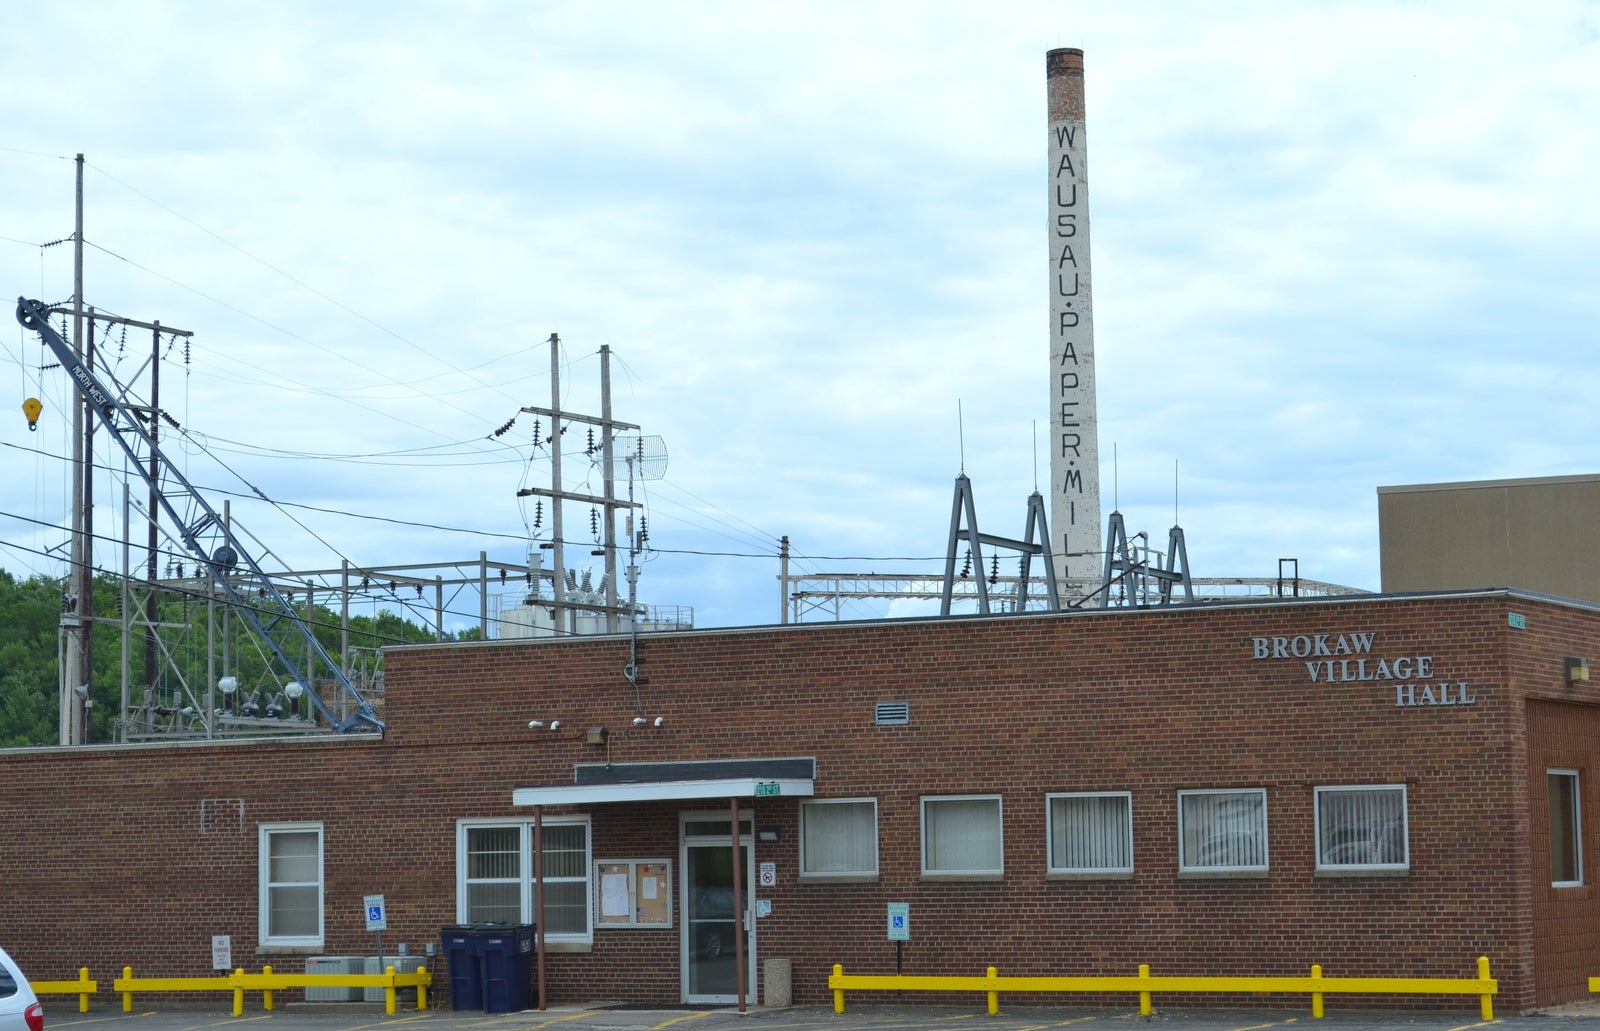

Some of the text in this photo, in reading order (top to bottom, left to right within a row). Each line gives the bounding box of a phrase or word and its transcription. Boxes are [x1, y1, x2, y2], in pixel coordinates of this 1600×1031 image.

[1056, 126, 1079, 297] WAUSAU
[72, 365, 108, 406] NORTH WEST
[1060, 312, 1081, 458] PAPER
[1252, 632, 1376, 660] BROKAW
[1305, 656, 1434, 683] VILLAGE
[1395, 682, 1476, 707] HALL
